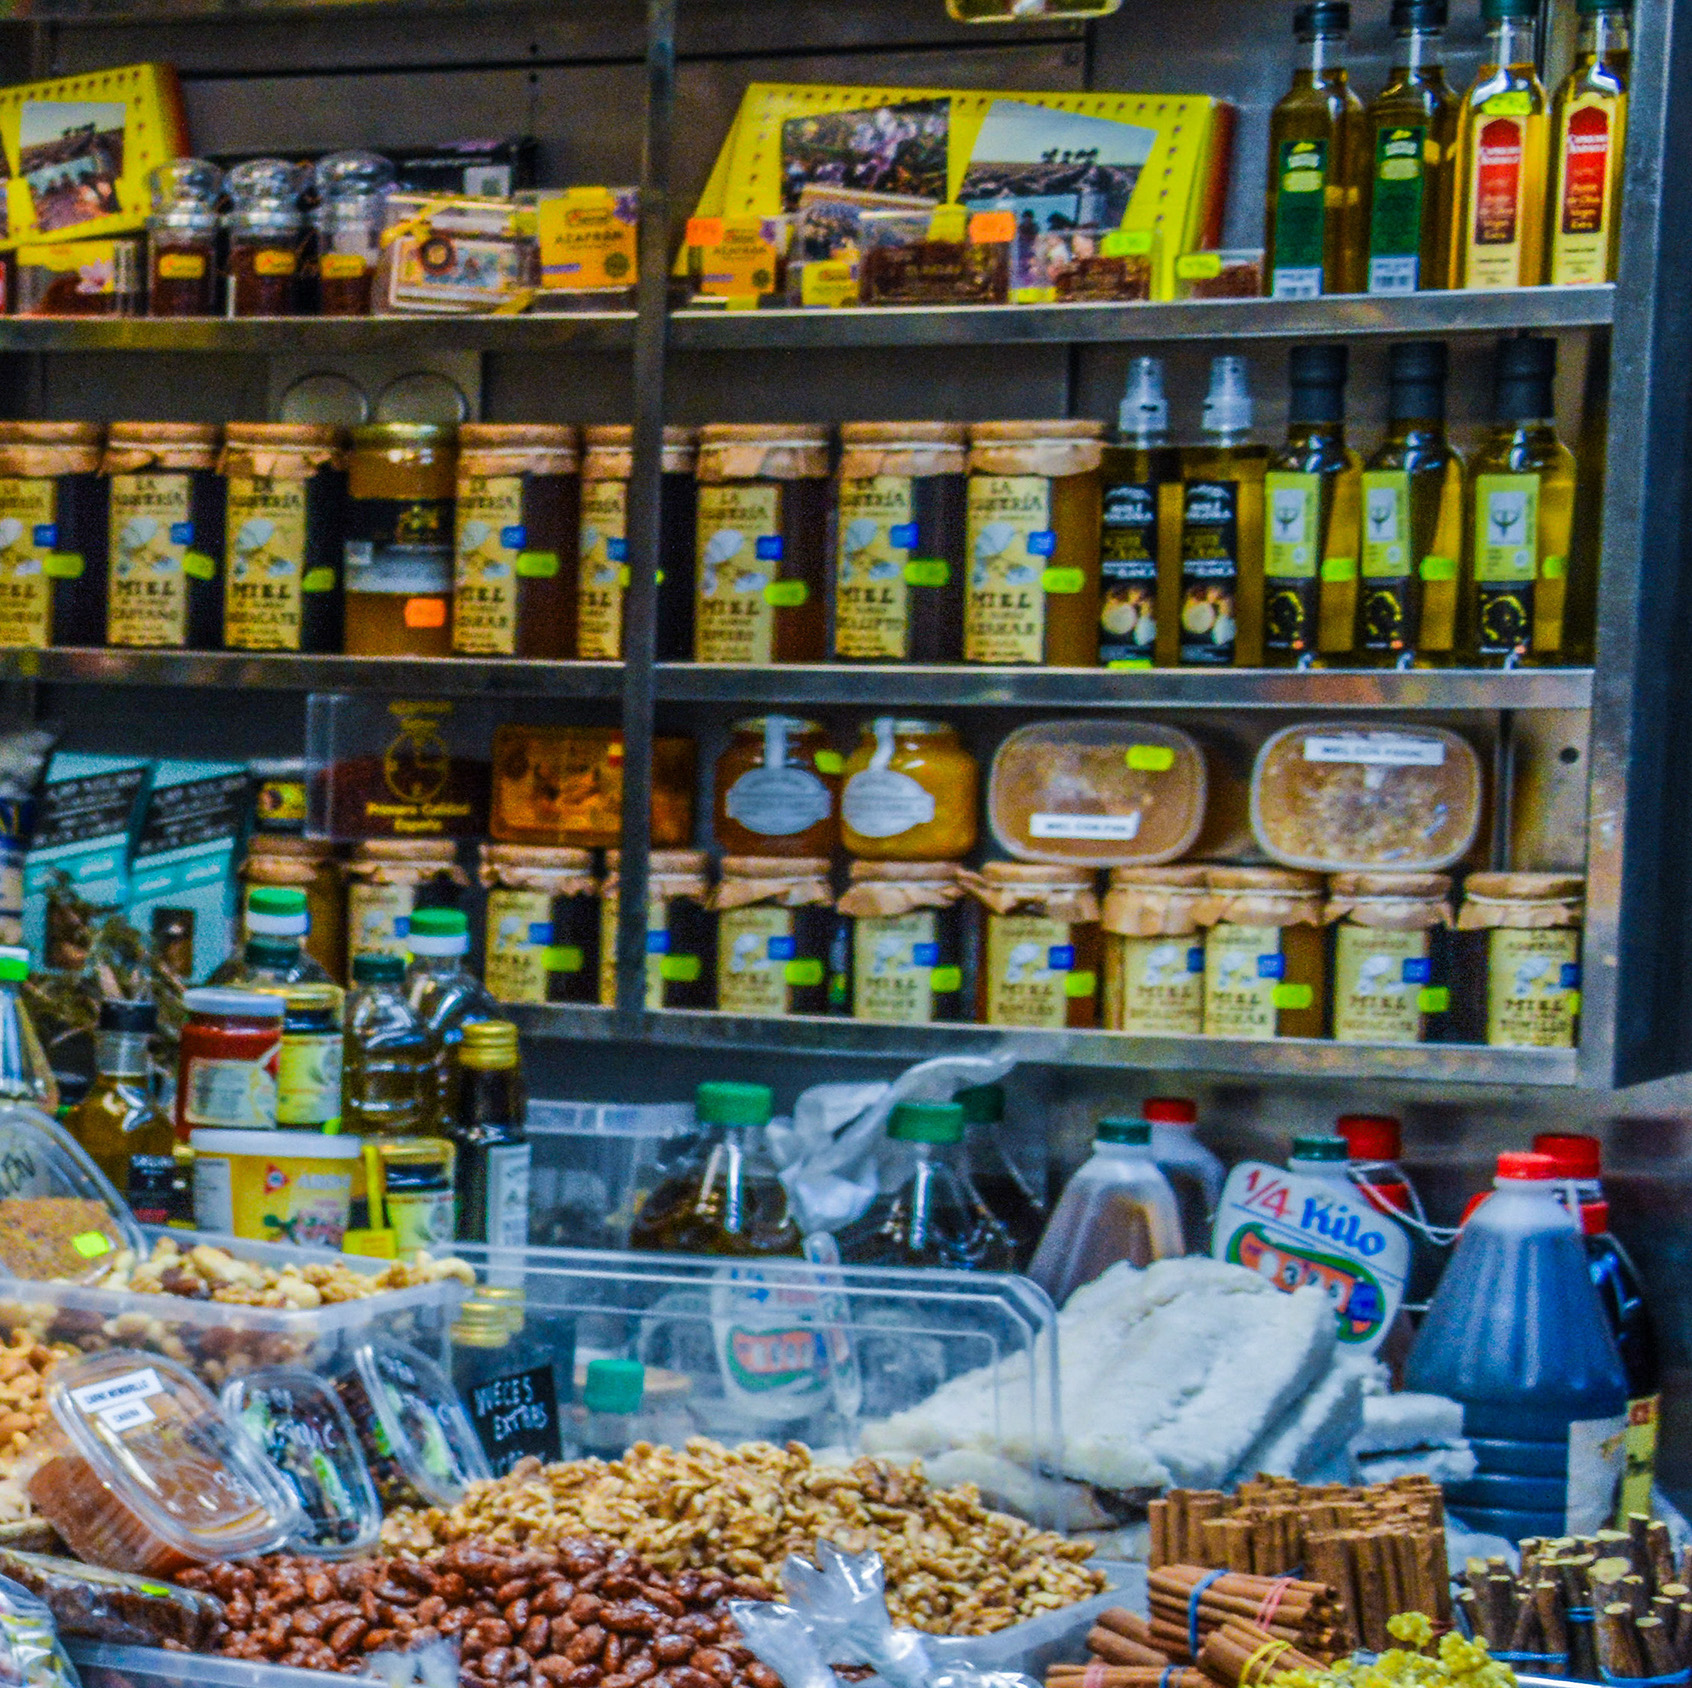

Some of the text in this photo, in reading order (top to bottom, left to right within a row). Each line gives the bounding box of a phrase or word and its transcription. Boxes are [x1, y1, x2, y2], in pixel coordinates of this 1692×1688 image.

[117, 581, 176, 596] MIEL
[232, 583, 291, 599] MIEL
[973, 593, 1032, 608] MIEL
[1246, 1169, 1387, 1257] 1/4 Kilo
